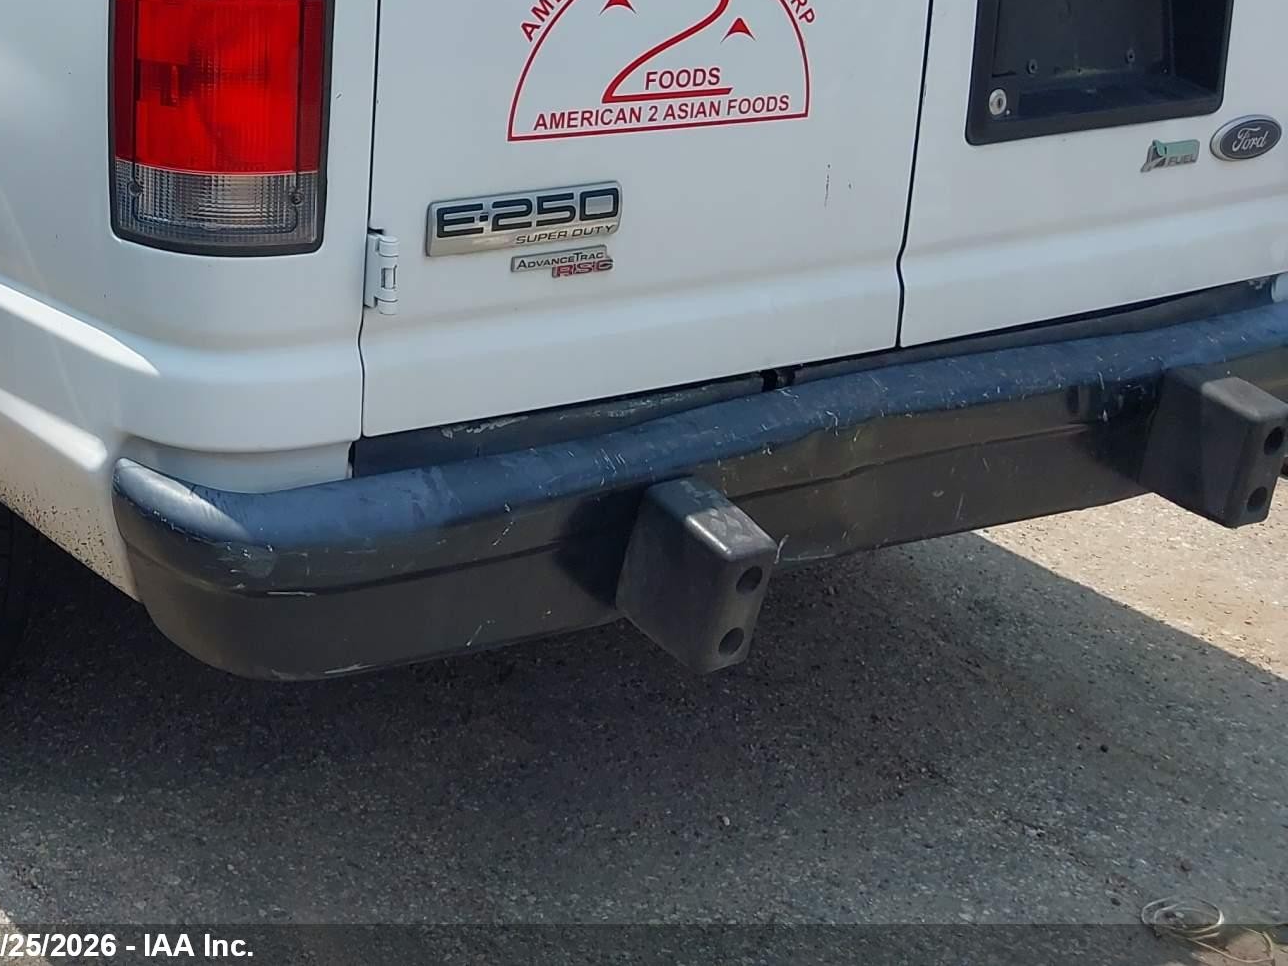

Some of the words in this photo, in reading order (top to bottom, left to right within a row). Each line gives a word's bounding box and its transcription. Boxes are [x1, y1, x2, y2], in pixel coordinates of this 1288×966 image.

[645, 67, 722, 90] FOODS
[533, 107, 642, 131] AMERICAN
[647, 105, 659, 122] 2
[662, 100, 722, 120] ASIAN
[726, 95, 790, 116] FOODS
[1231, 127, 1269, 152] Ford
[516, 230, 568, 244] SUPER
[571, 224, 616, 238] DUTY
[552, 259, 614, 278] RSC
